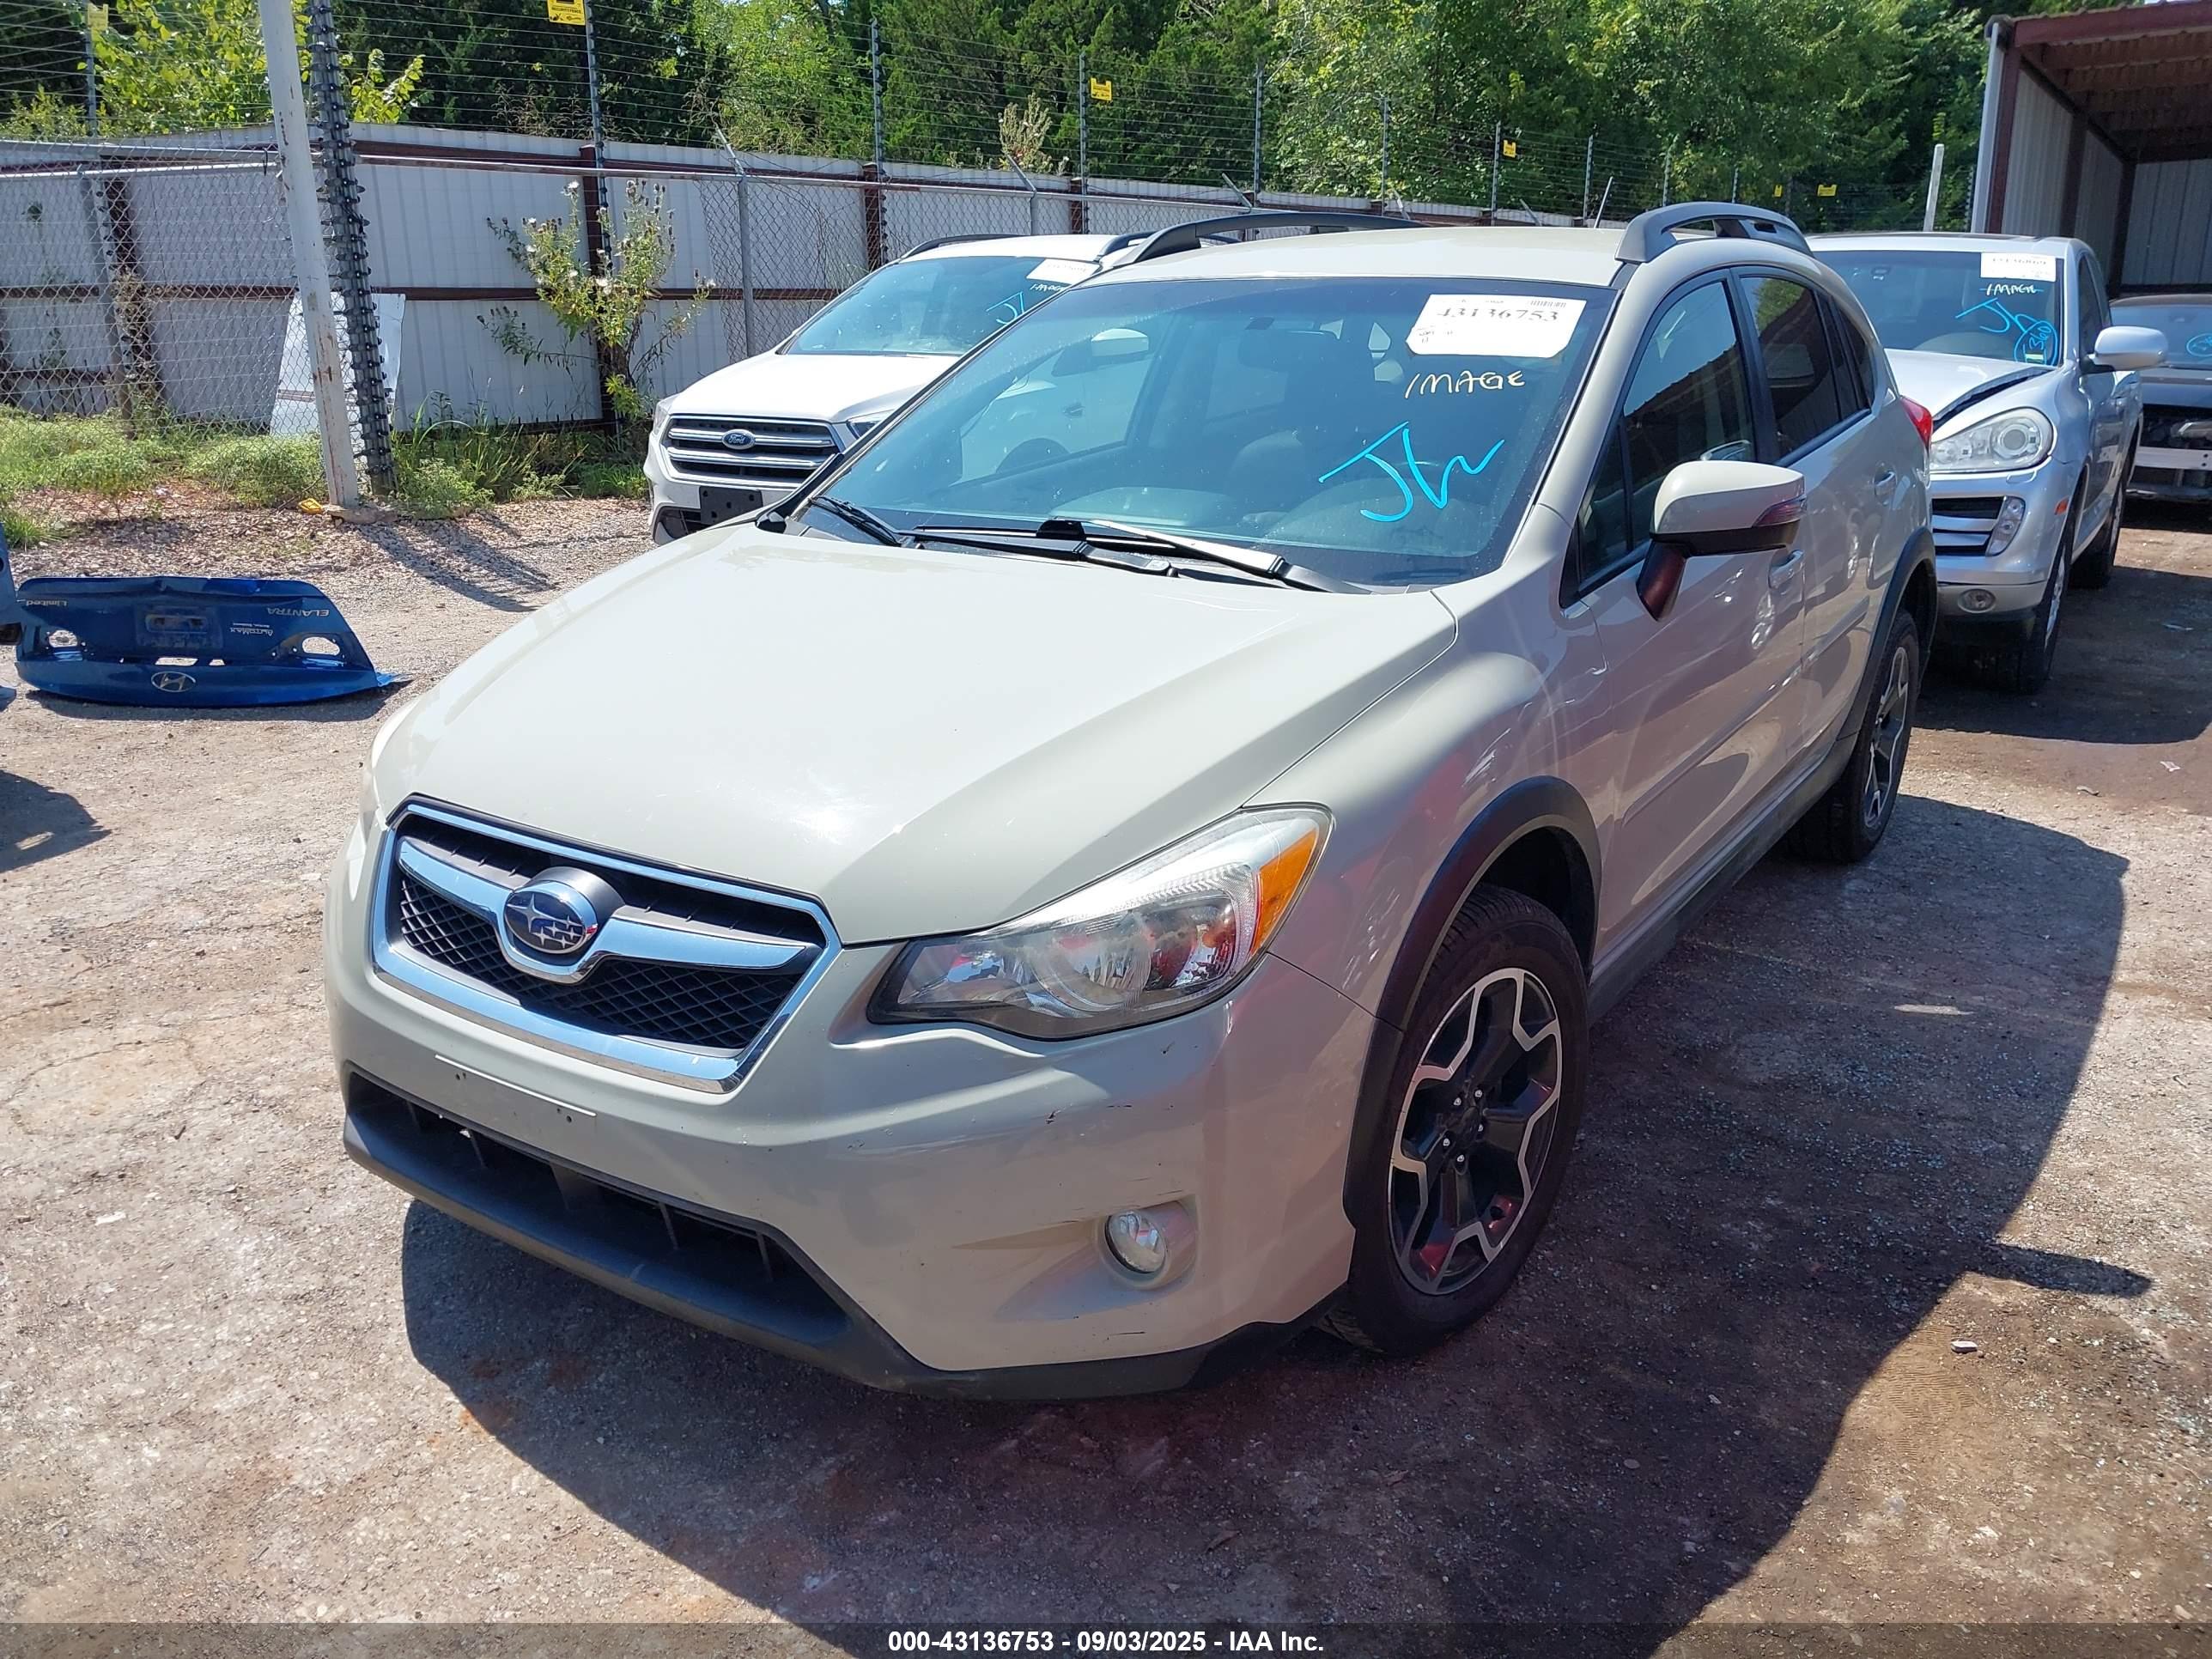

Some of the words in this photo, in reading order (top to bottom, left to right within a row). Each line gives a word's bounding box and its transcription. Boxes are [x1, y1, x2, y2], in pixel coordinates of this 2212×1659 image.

[1405, 370, 1526, 398] IMAGE
[728, 434, 746, 444] Ford
[267, 607, 330, 617] ELANTRA
